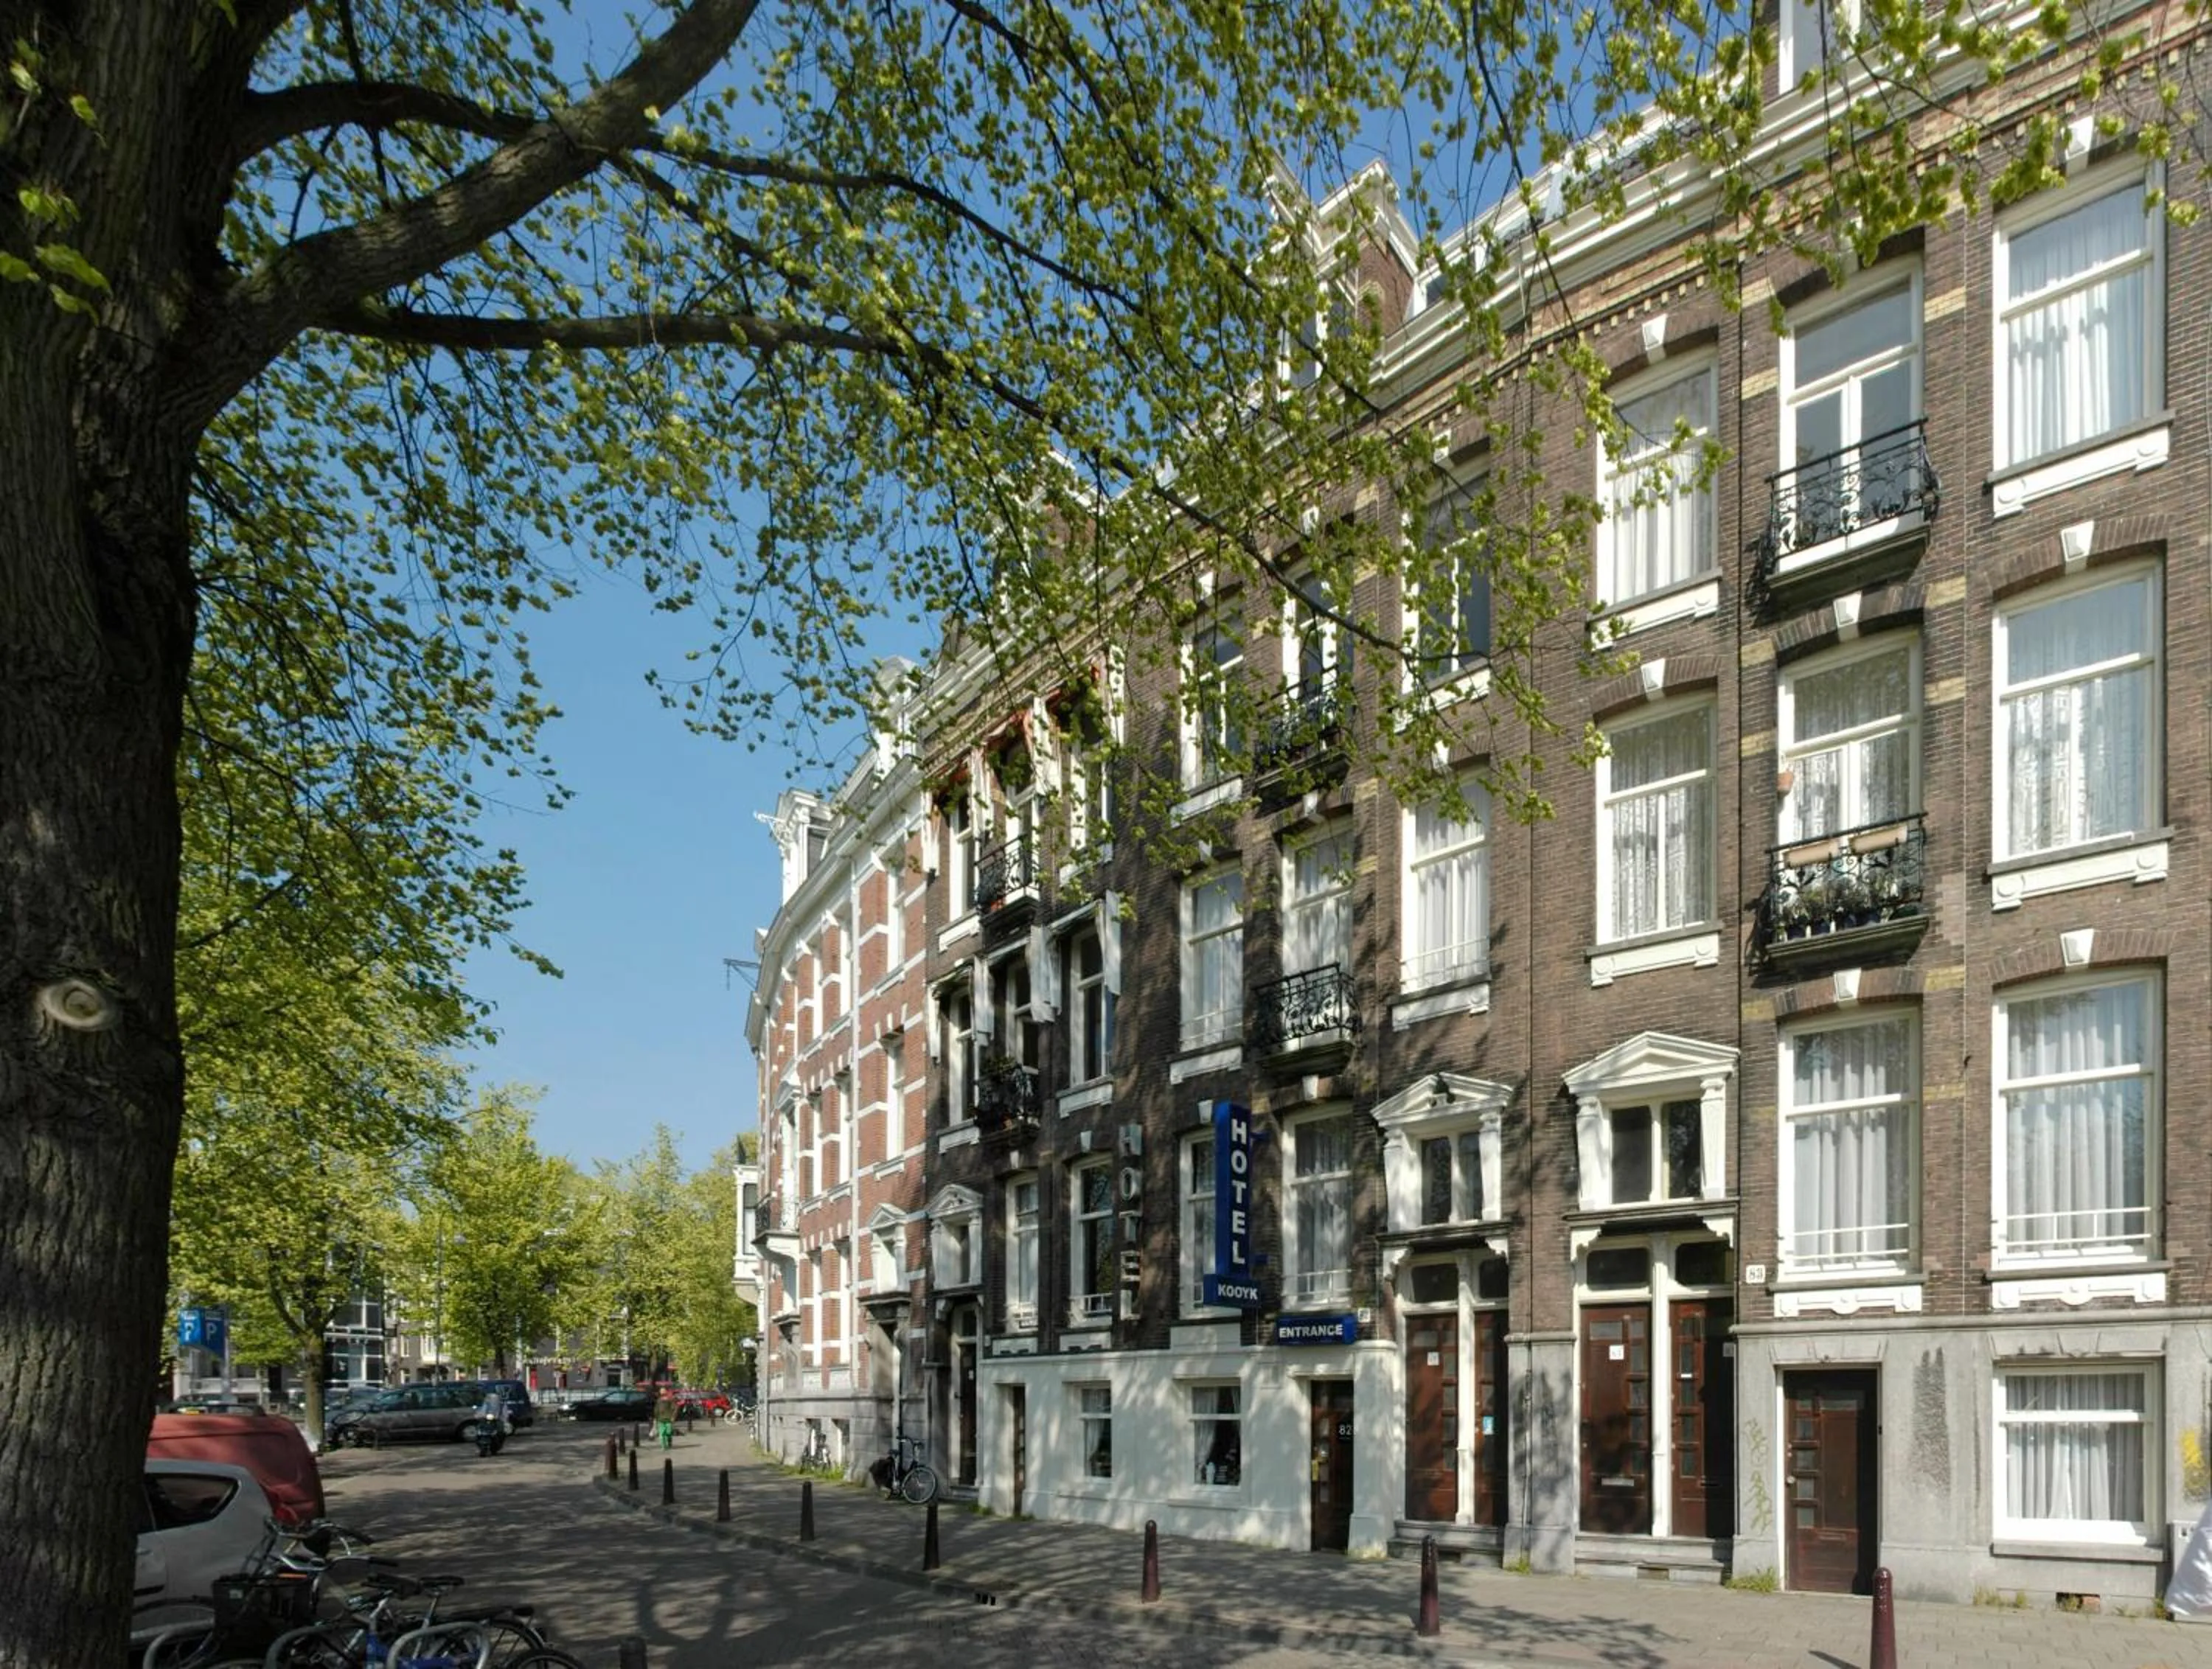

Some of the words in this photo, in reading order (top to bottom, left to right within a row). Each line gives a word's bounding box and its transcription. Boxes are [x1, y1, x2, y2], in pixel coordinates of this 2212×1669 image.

[1231, 1118, 1247, 1264] HOTEL
[1119, 1124, 1142, 1320] HOTEL
[1218, 1283, 1258, 1300] KOOYK
[184, 1323, 195, 1341] P
[1279, 1324, 1343, 1338] ENTRANCE
